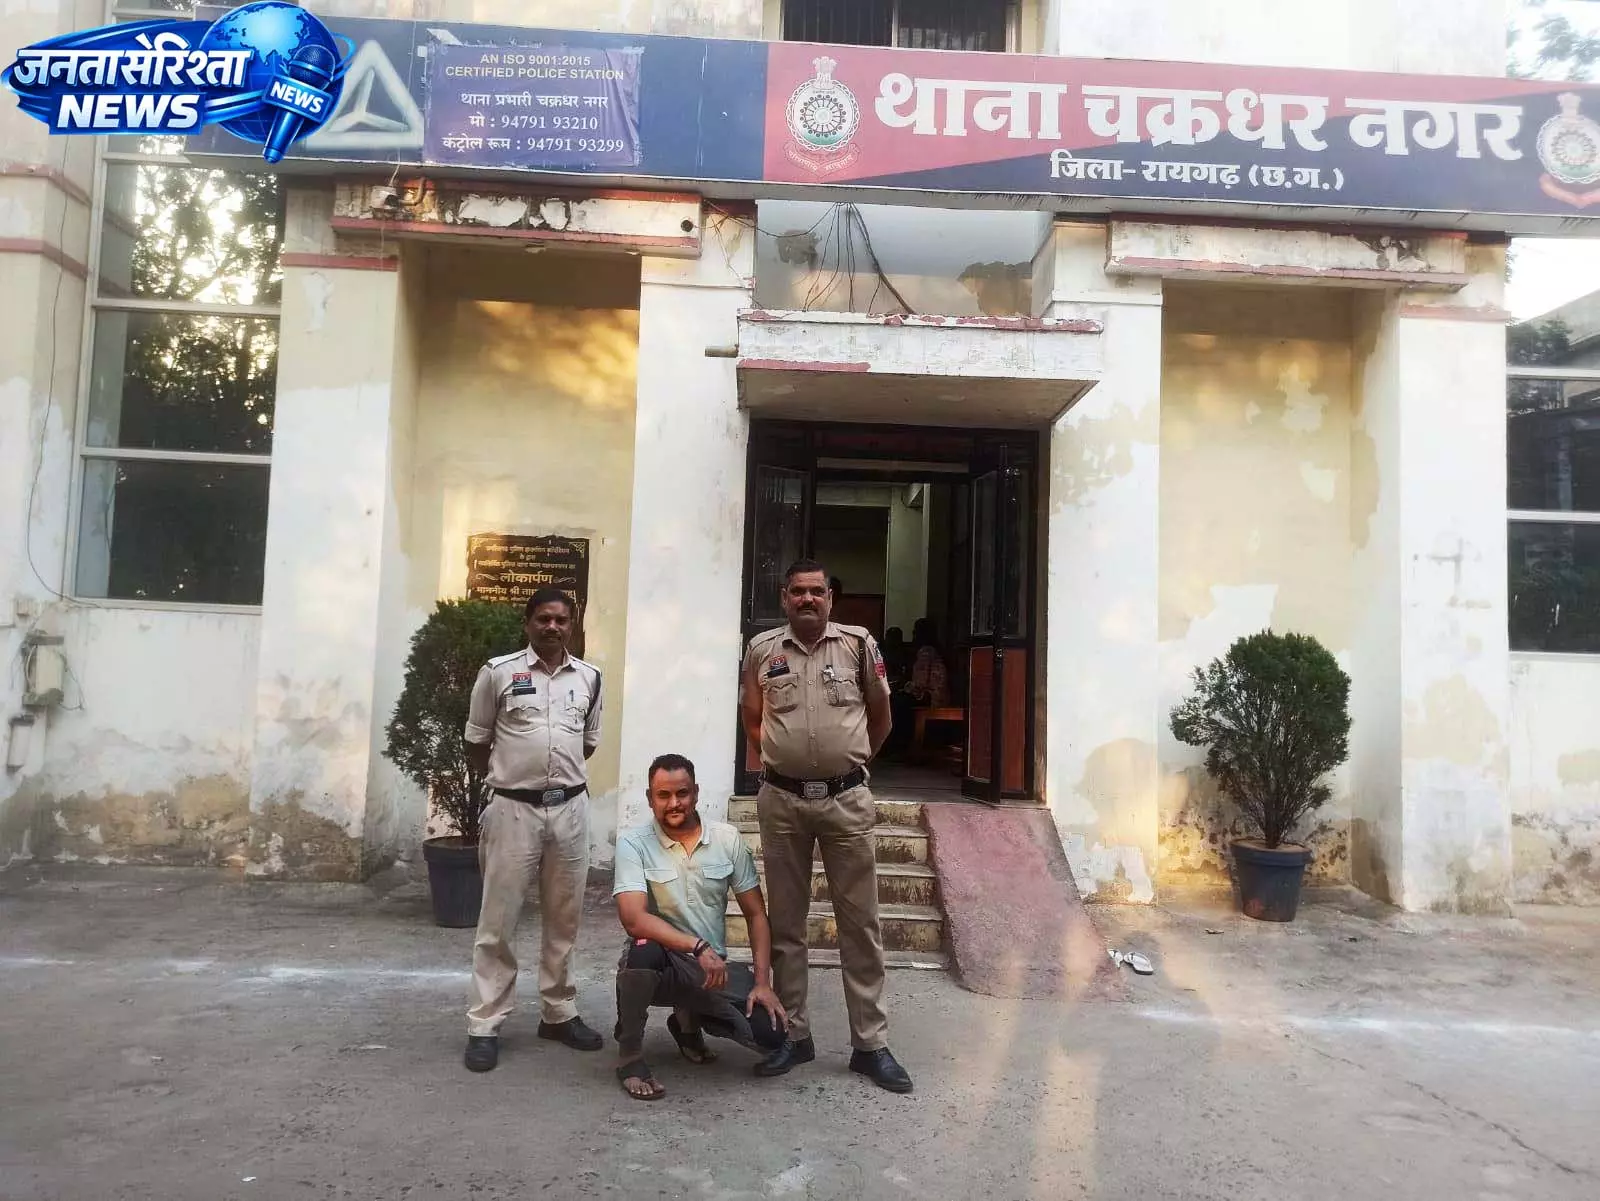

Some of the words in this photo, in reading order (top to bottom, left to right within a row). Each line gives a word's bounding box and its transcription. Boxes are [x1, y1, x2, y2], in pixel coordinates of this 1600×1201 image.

[480, 54, 499, 64] AN
[503, 54, 525, 65] ISO
[528, 55, 592, 66] 9001:2015
[445, 66, 515, 78] CERTIFIED
[518, 67, 566, 79] POLICE
[570, 69, 624, 80] STATION
[461, 93, 491, 106] थाना
[494, 91, 532, 107] प्रभारी
[535, 95, 579, 108] चक्रधर
[583, 96, 608, 109] नगर
[501, 115, 547, 129] 94791
[552, 116, 598, 130] 93210
[875, 72, 1067, 140] थाना
[1081, 84, 1329, 152] चक्रधर
[1345, 97, 1523, 162] नगर
[441, 132, 483, 153] कंट्रोल
[486, 138, 511, 150] रूम
[527, 137, 573, 151] 94791
[578, 138, 624, 153] 93299
[1248, 163, 1344, 191] (छ.ग.)
[500, 569, 553, 584] लोकार्पण
